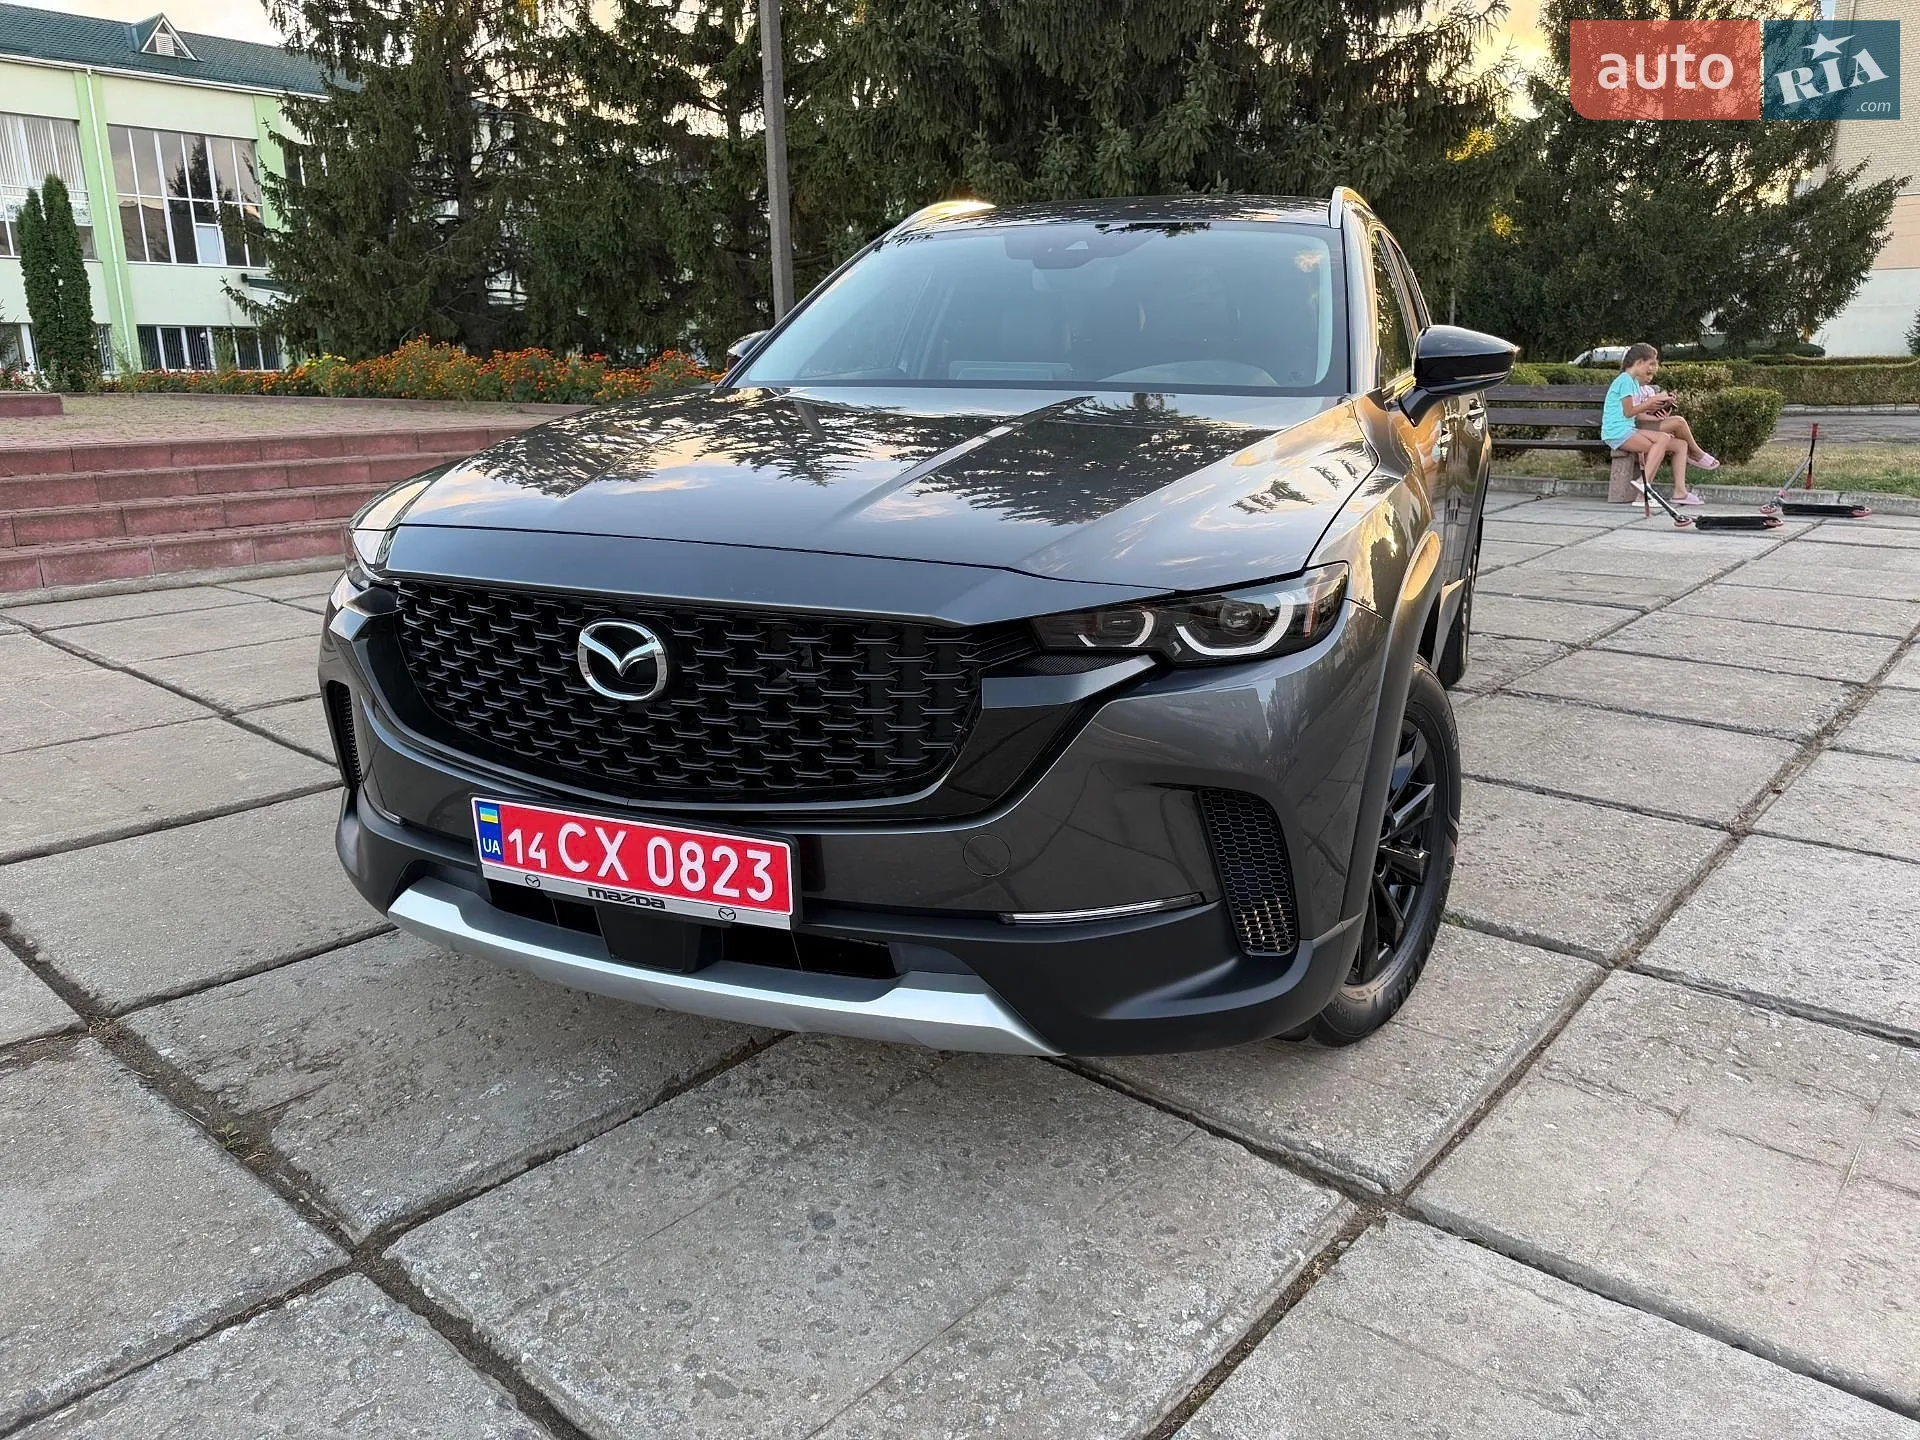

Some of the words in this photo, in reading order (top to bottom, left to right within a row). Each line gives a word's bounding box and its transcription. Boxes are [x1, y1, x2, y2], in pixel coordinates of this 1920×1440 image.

[482, 837, 501, 855] UA
[646, 836, 773, 903] 0823
[587, 887, 666, 910] mazda
